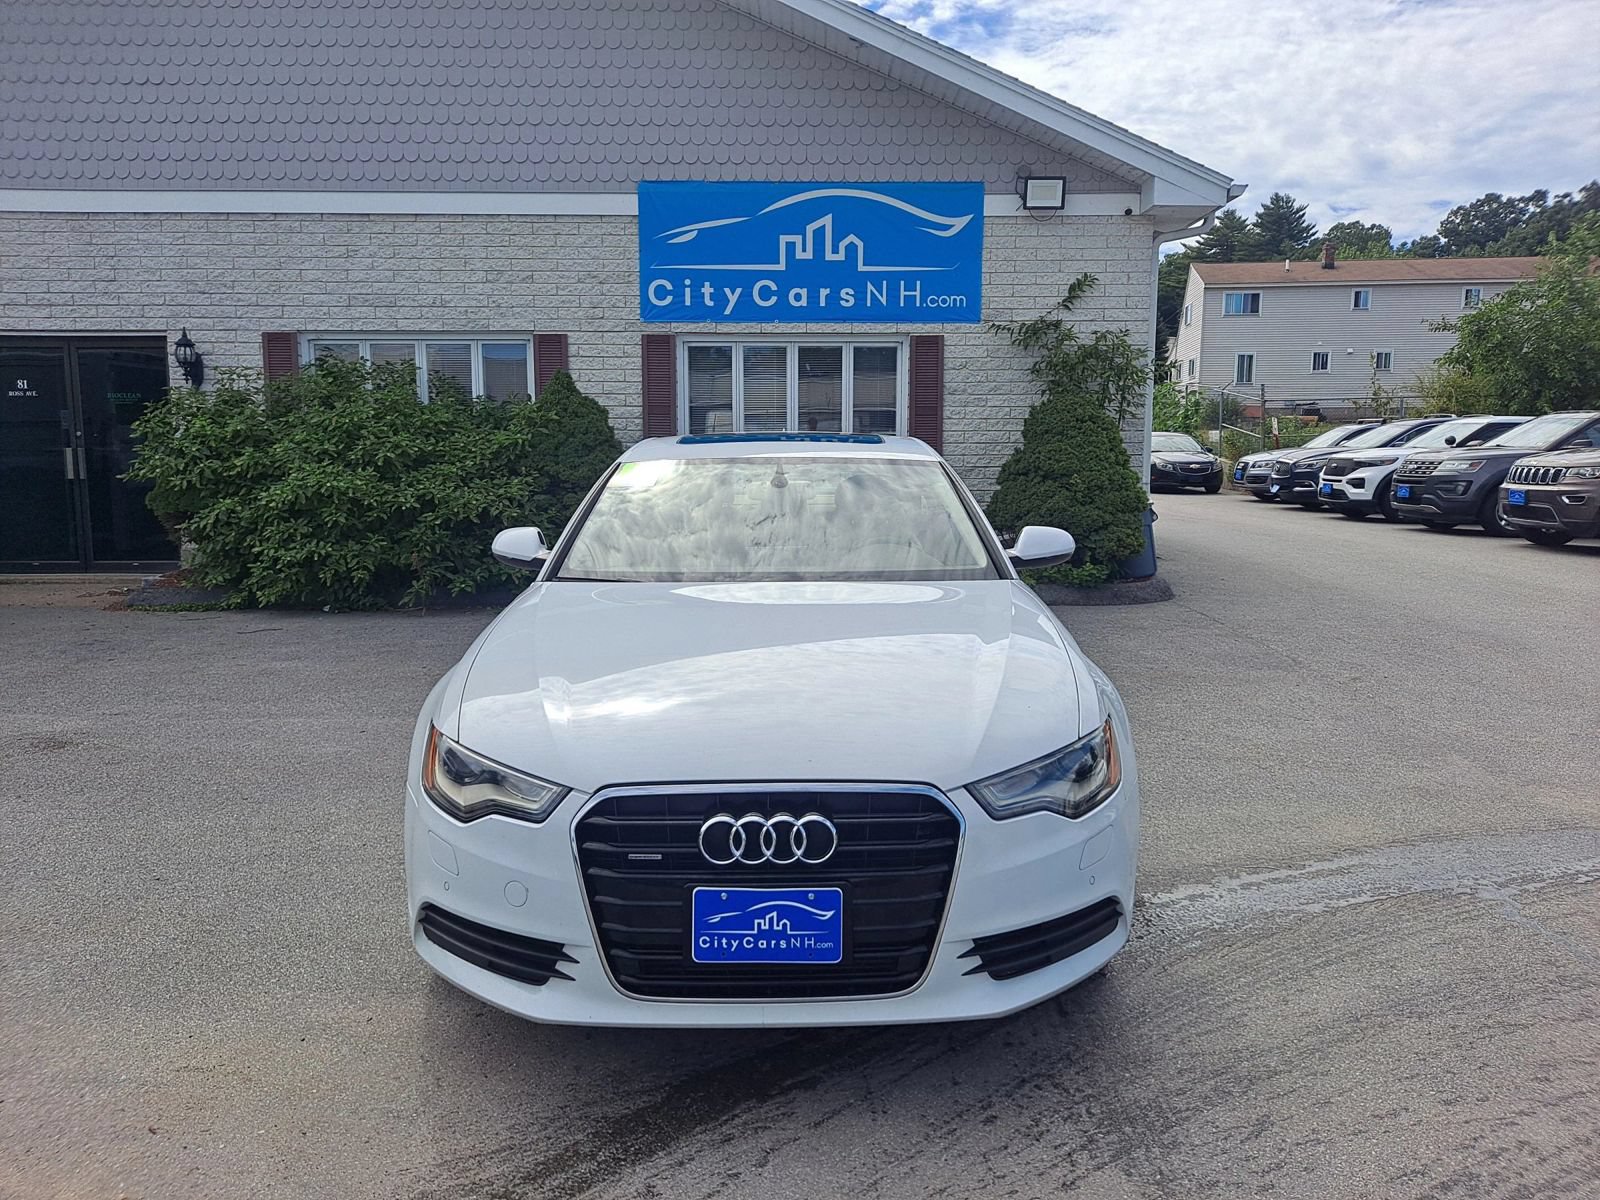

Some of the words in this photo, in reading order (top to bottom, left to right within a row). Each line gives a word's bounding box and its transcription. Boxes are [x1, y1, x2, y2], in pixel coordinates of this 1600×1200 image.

[647, 278, 967, 315] CityCarsNH.com
[17, 379, 28, 389] 81
[699, 935, 834, 952] CityCarsNH.com
